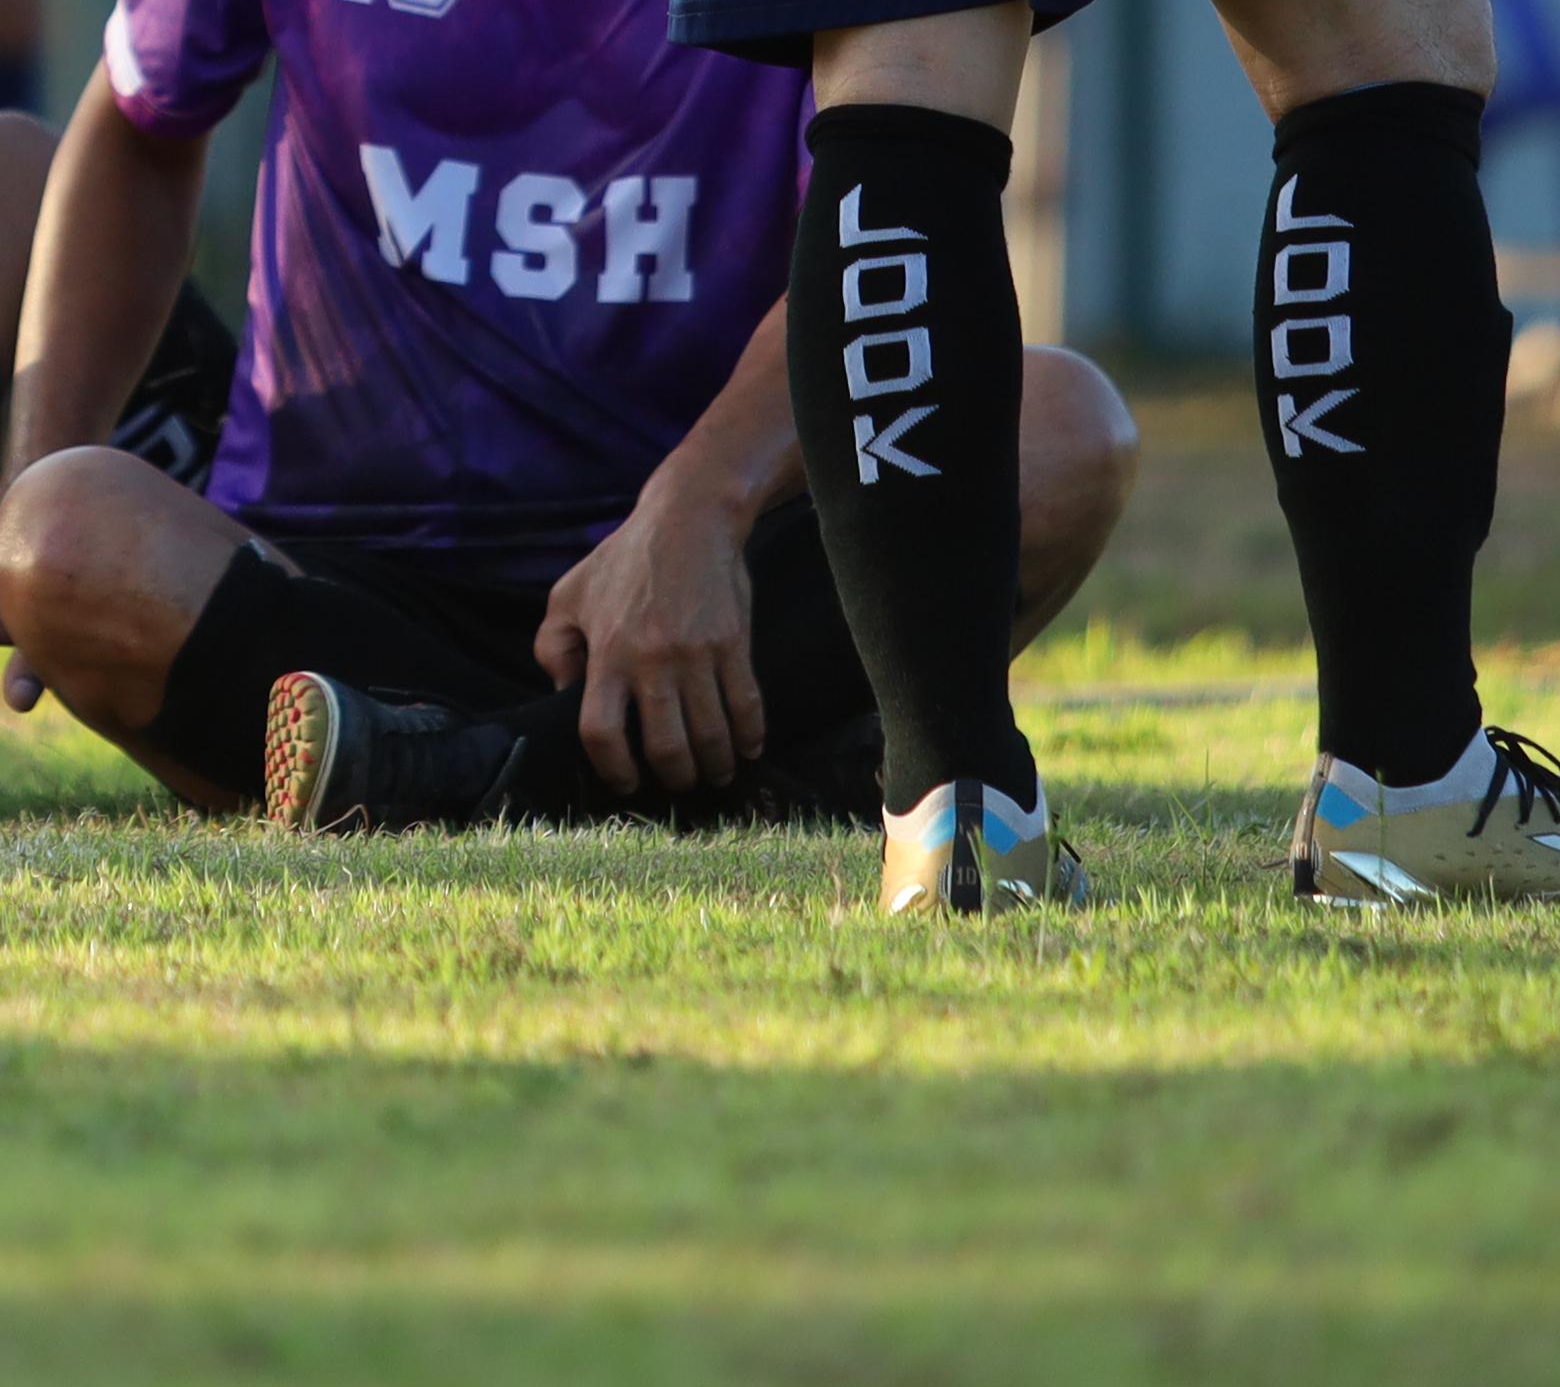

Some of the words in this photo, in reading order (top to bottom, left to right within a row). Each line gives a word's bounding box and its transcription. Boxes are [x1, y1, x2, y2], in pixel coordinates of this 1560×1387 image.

[359, 143, 698, 304] MSH
[839, 182, 943, 486] LOOK
[1271, 172, 1366, 458] LOOK
